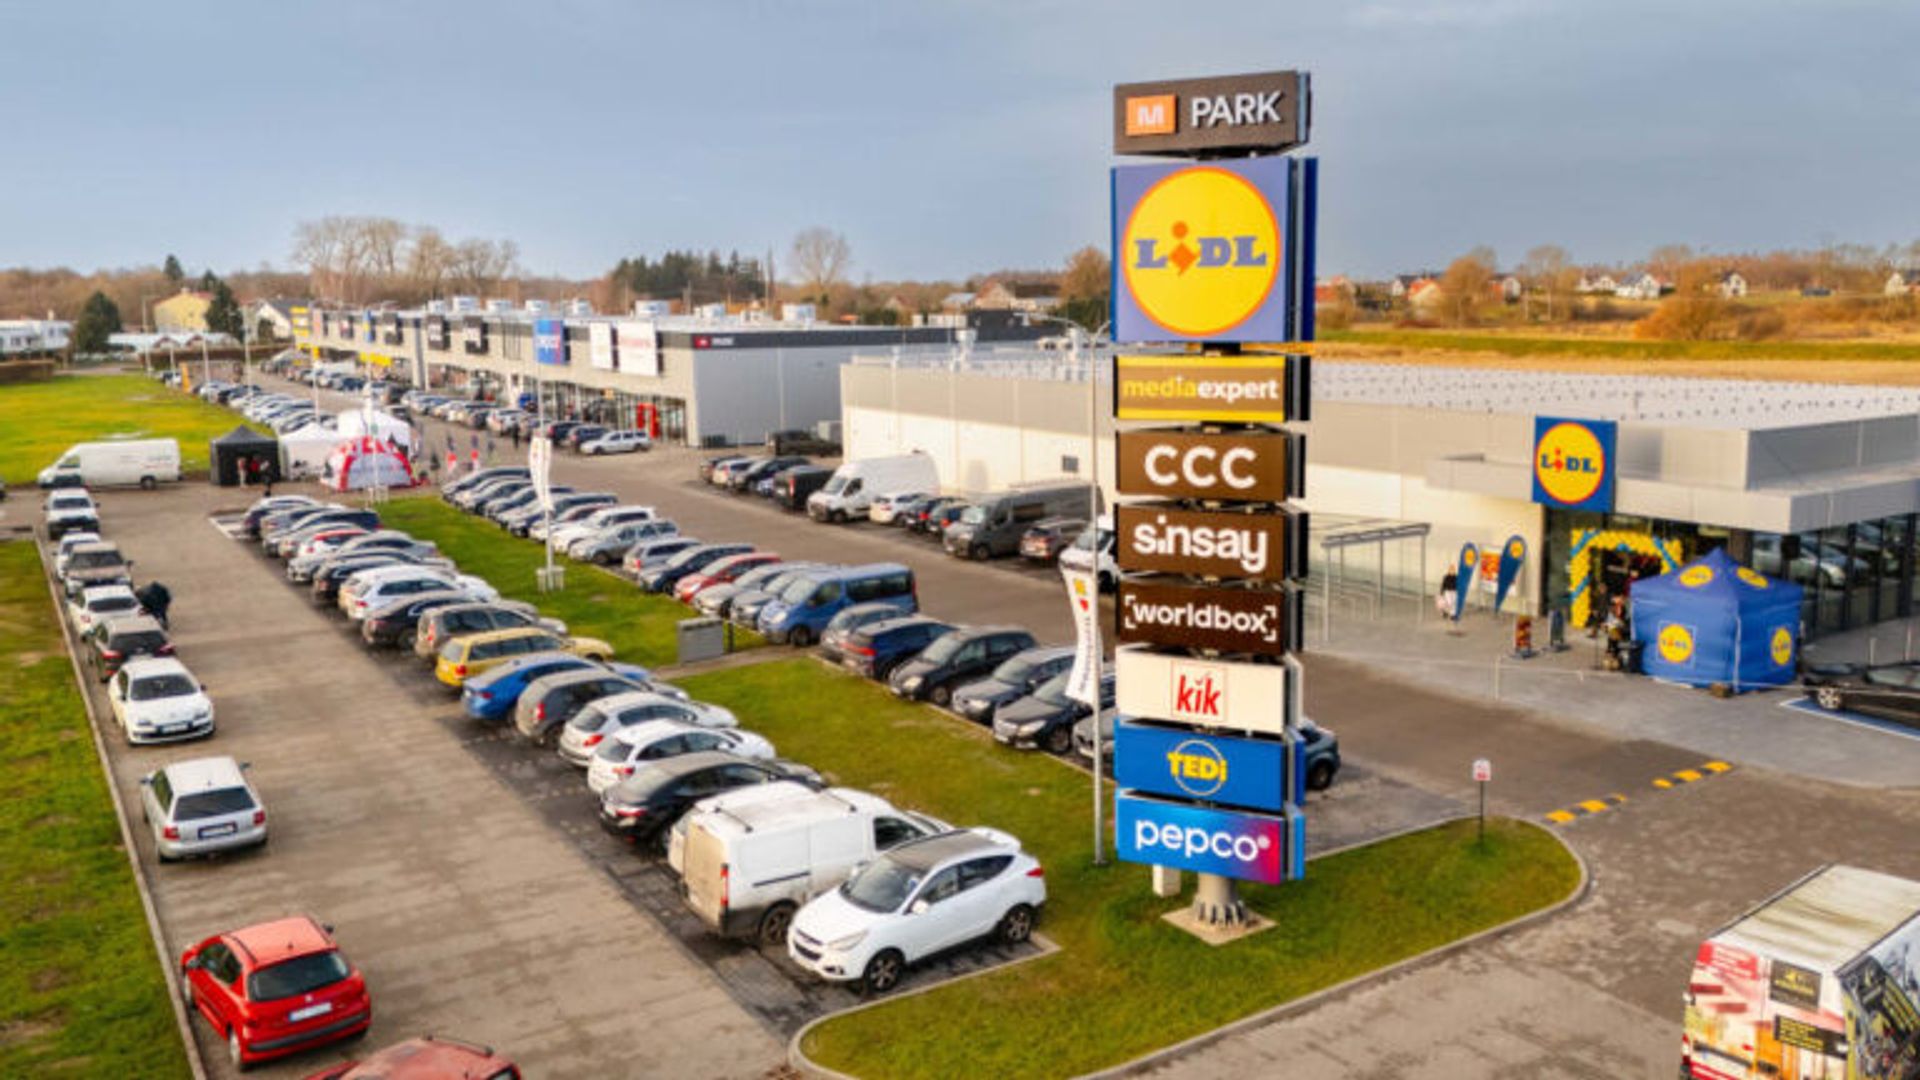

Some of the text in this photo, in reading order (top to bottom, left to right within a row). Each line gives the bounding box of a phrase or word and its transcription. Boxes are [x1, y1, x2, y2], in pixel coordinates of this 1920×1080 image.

[1137, 90, 1282, 127] M PARK
[1123, 375, 1280, 404] mediaexpert
[1144, 445, 1257, 489] CCC
[1133, 515, 1268, 573] sinsay
[1132, 602, 1268, 633] worldbox
[1135, 819, 1259, 862] pepco
